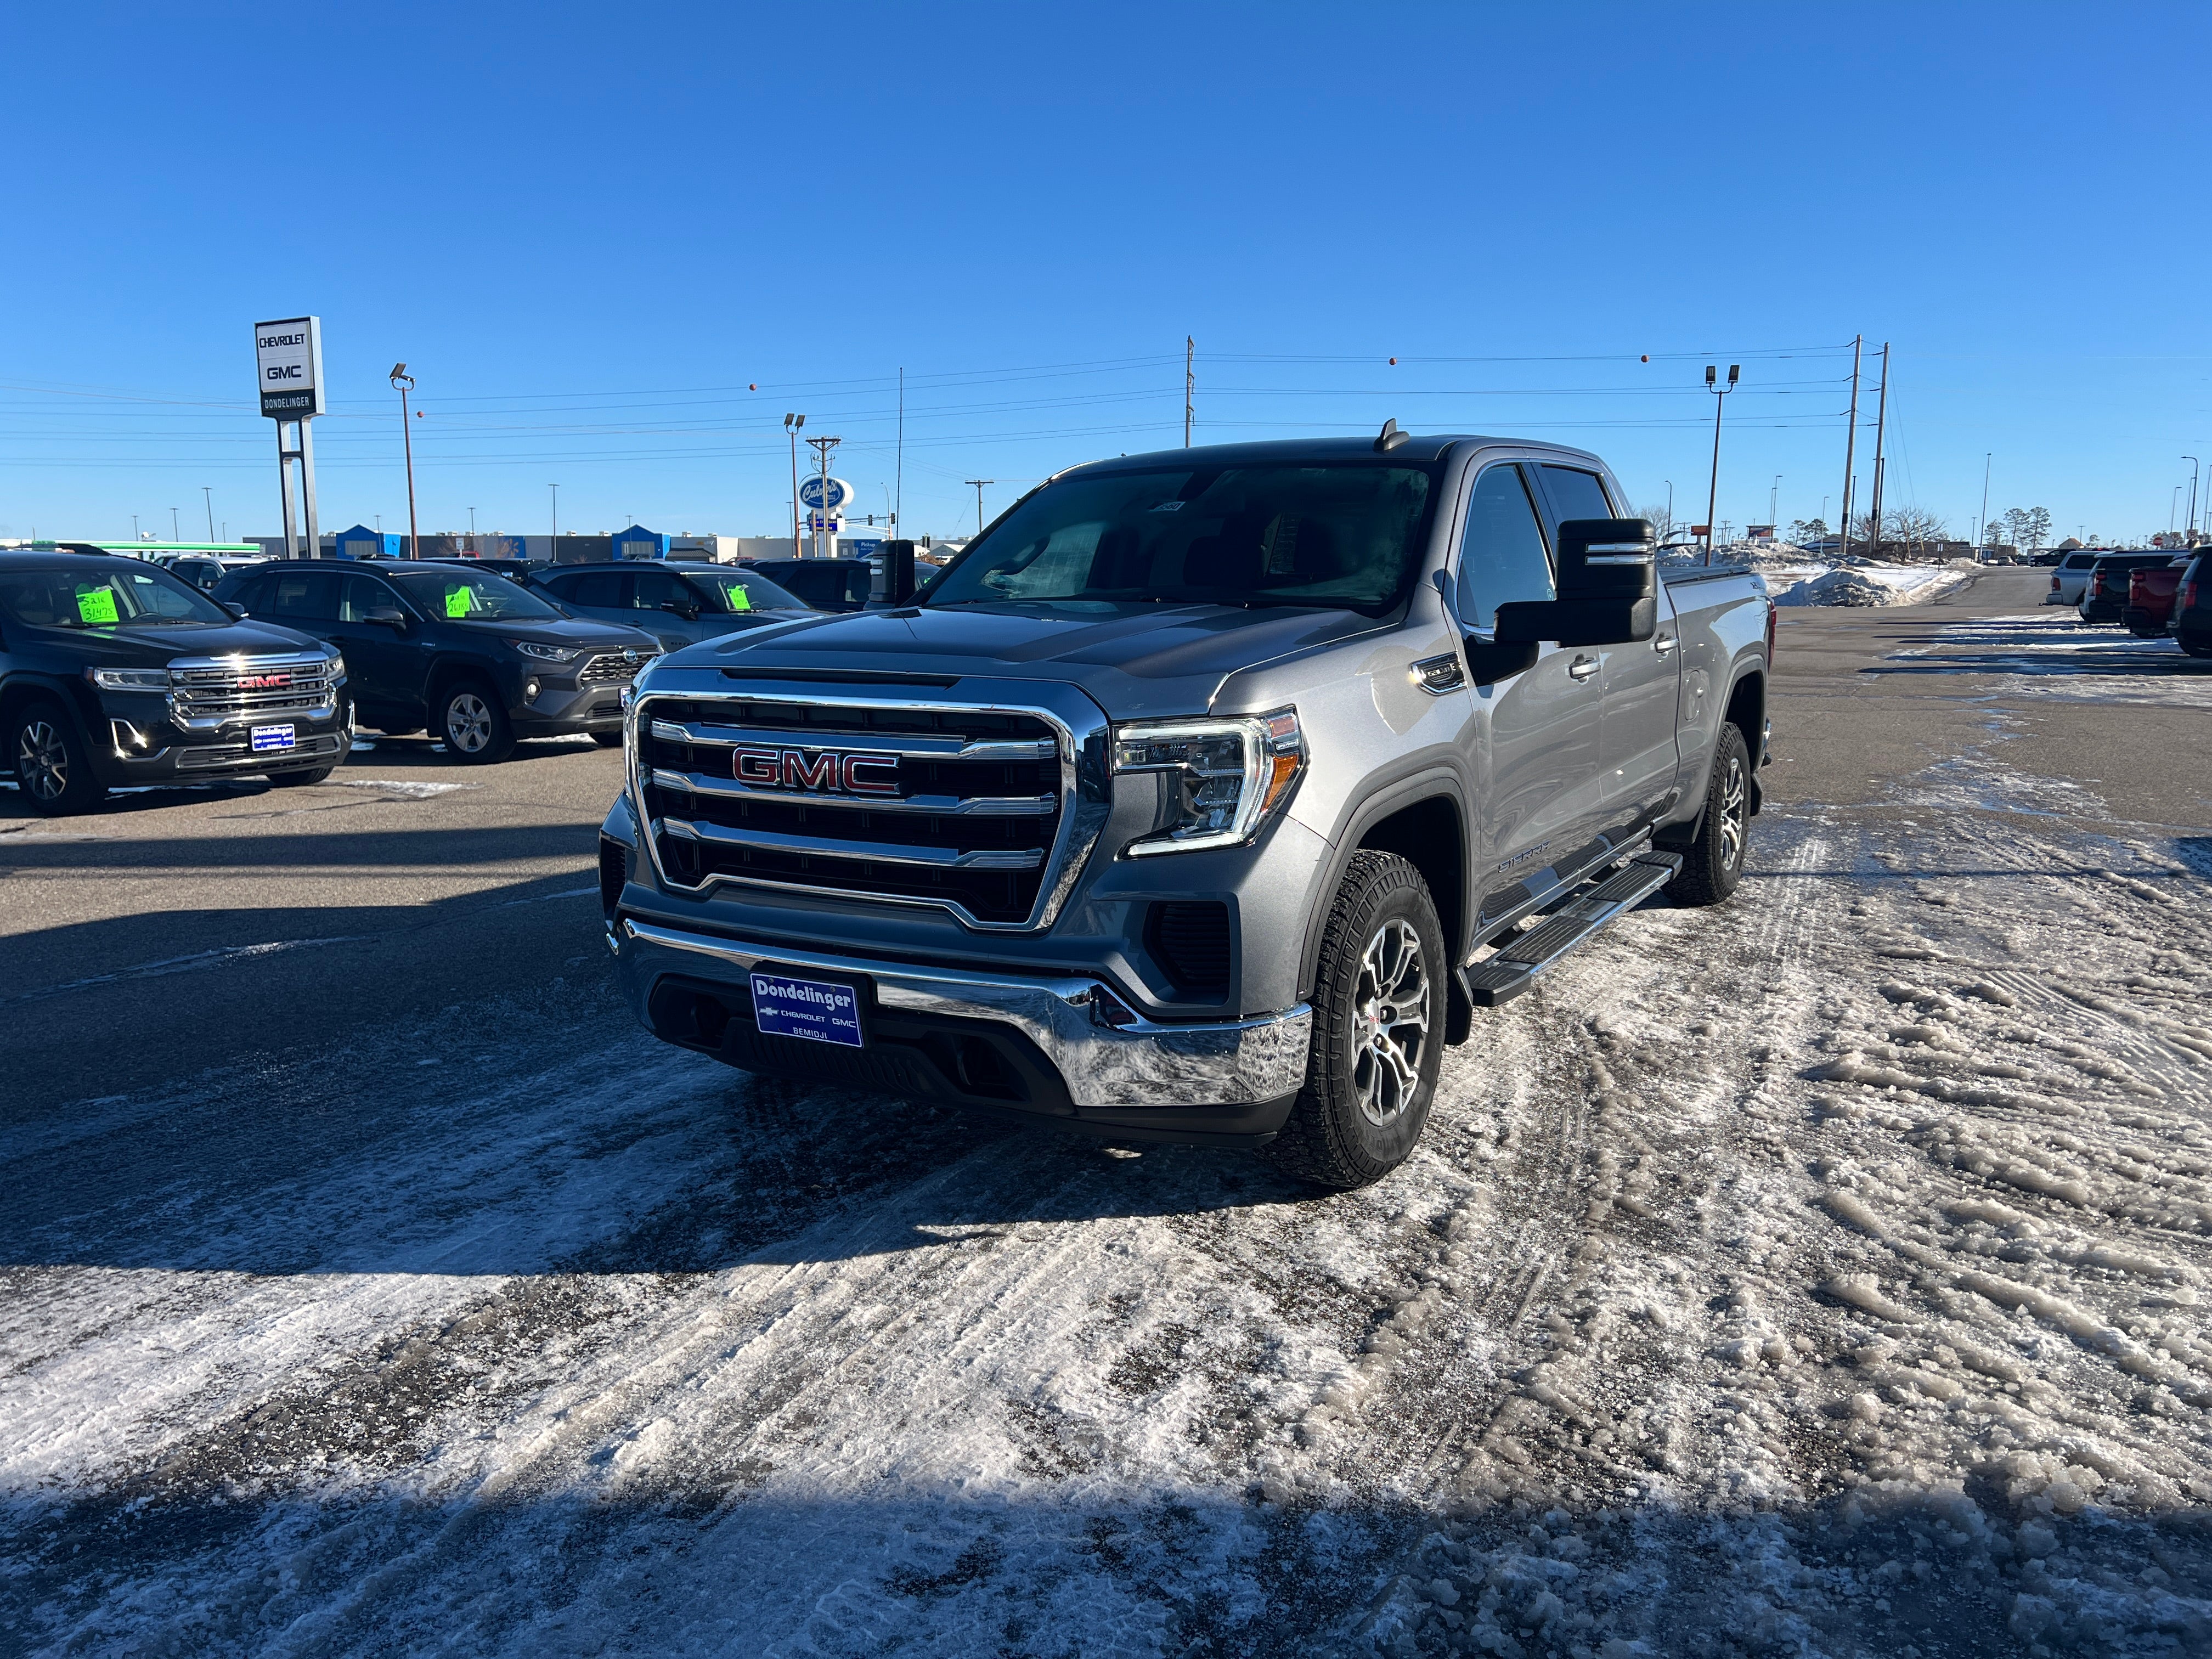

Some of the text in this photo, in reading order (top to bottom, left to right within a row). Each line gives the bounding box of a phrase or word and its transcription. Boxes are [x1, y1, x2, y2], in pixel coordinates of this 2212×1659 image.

[259, 334, 305, 348] CHEVROLET
[267, 365, 302, 380] GMC
[264, 396, 309, 409] DONDELINGER
[802, 481, 837, 502] Culvr's
[236, 674, 291, 689] GMC
[732, 746, 901, 794] GMC
[755, 979, 851, 1011] Dondelinger
[781, 1010, 856, 1028] CHEVROLET GMC
[793, 1027, 827, 1040] BEMIDJI
